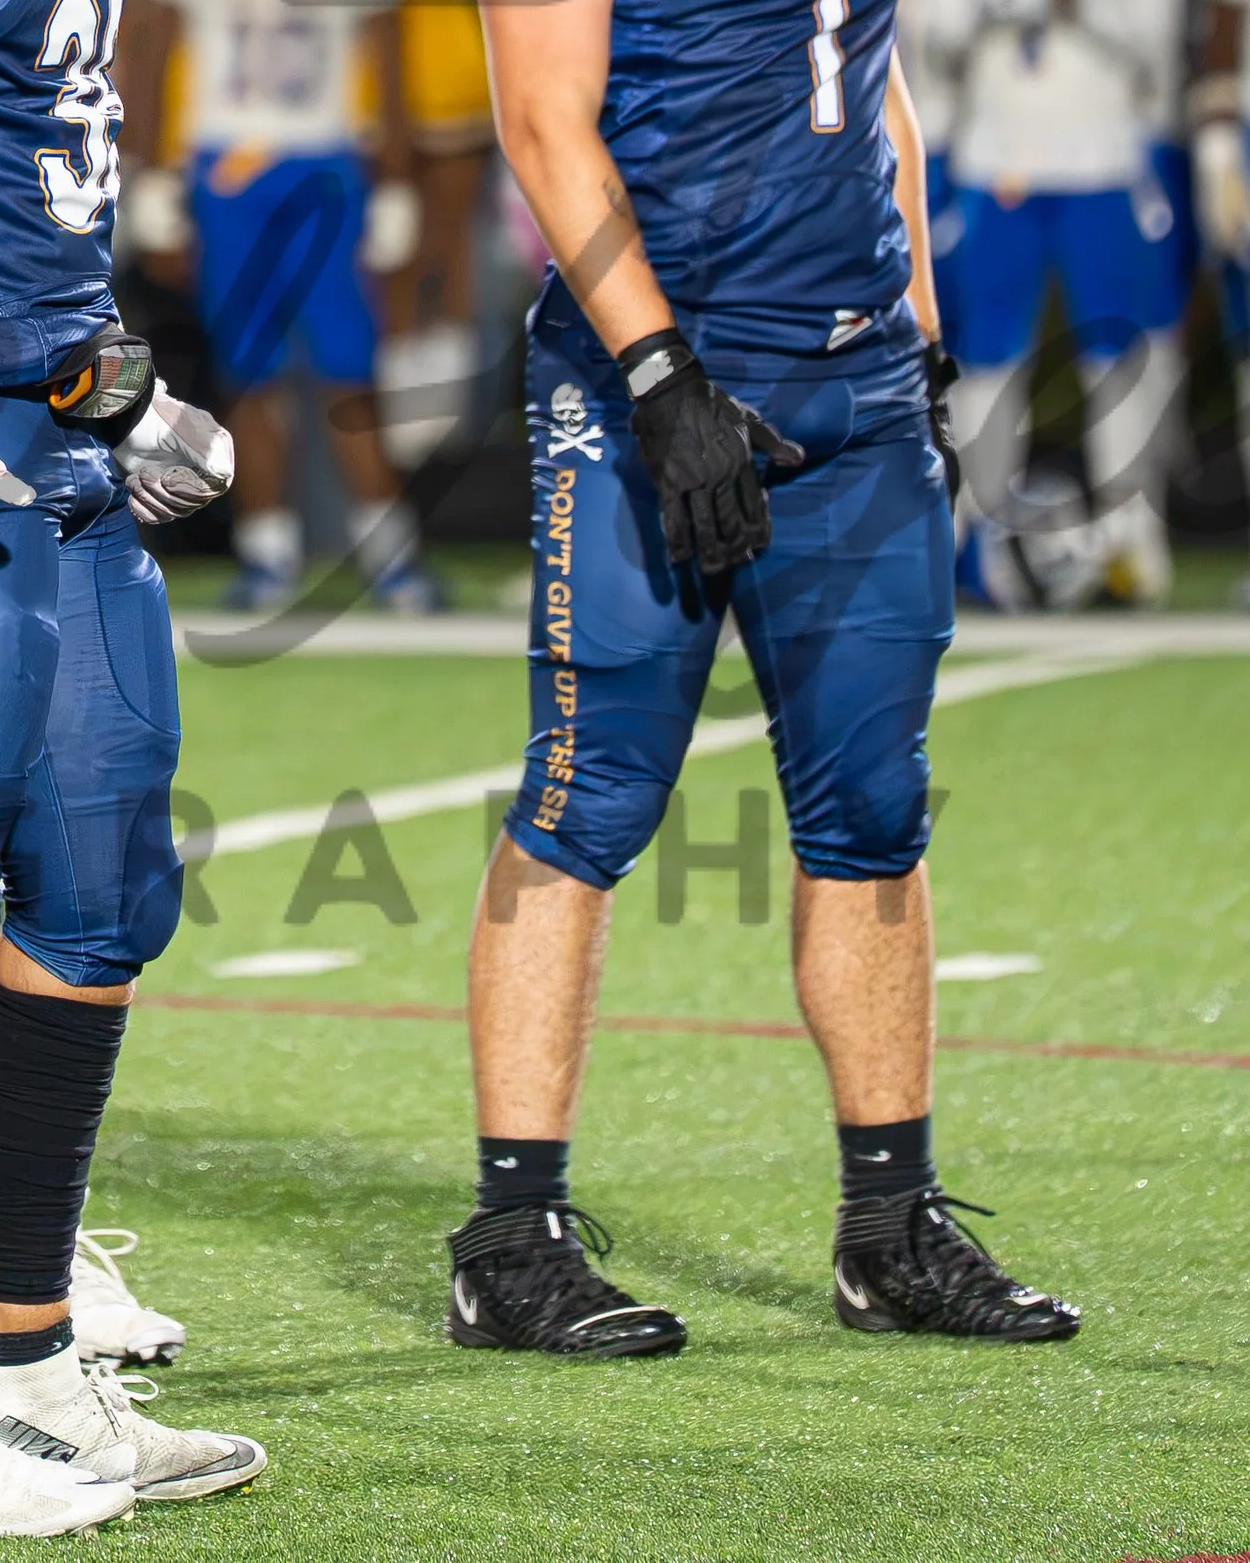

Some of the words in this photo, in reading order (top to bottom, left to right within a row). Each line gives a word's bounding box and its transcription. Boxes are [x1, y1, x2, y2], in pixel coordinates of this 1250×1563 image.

[548, 468, 576, 576] DON'T
[547, 580, 573, 663] GIVE
[554, 670, 577, 717] UP
